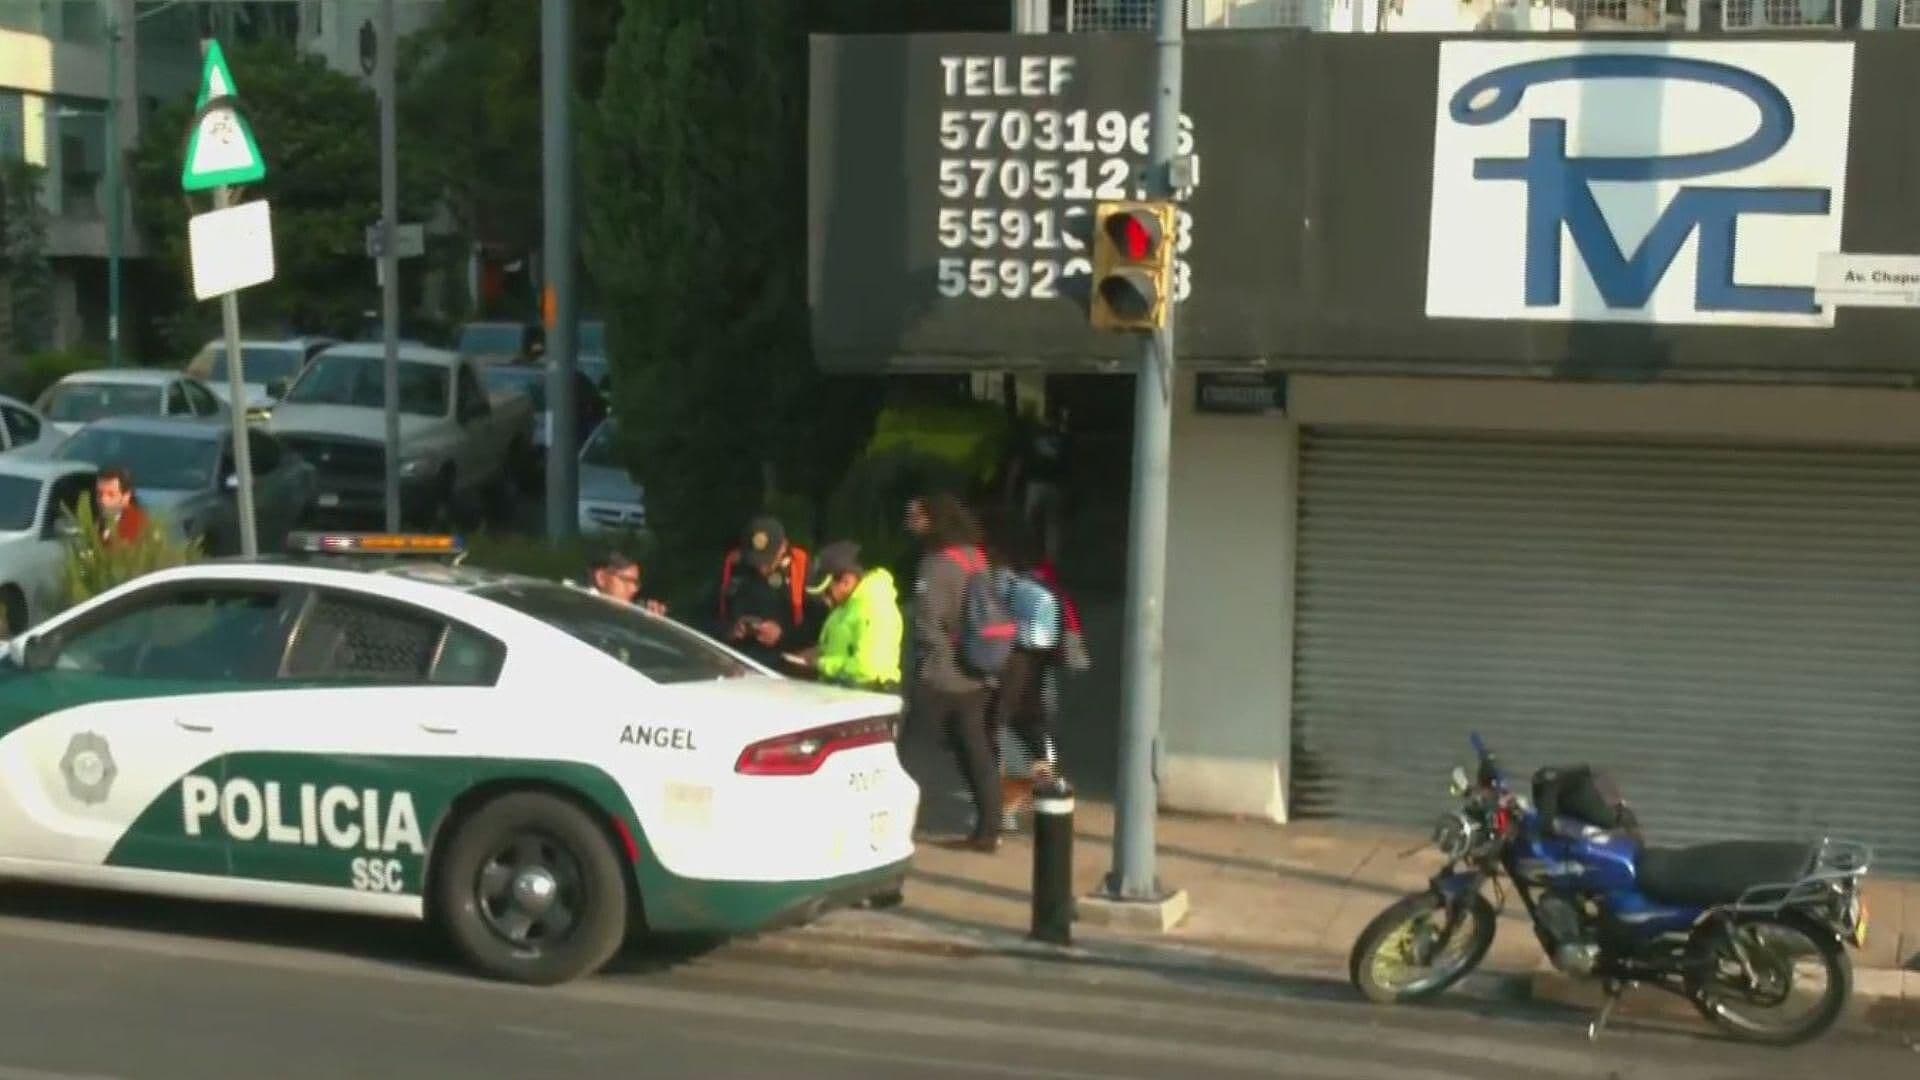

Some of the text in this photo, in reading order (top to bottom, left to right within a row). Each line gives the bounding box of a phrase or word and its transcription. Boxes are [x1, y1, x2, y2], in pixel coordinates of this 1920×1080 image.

[941, 56, 1075, 96] TELEF
[939, 157, 1195, 200] 570512
[620, 724, 697, 750] ANGEL
[182, 775, 425, 855] POLICIA
[352, 857, 403, 892] SSC
